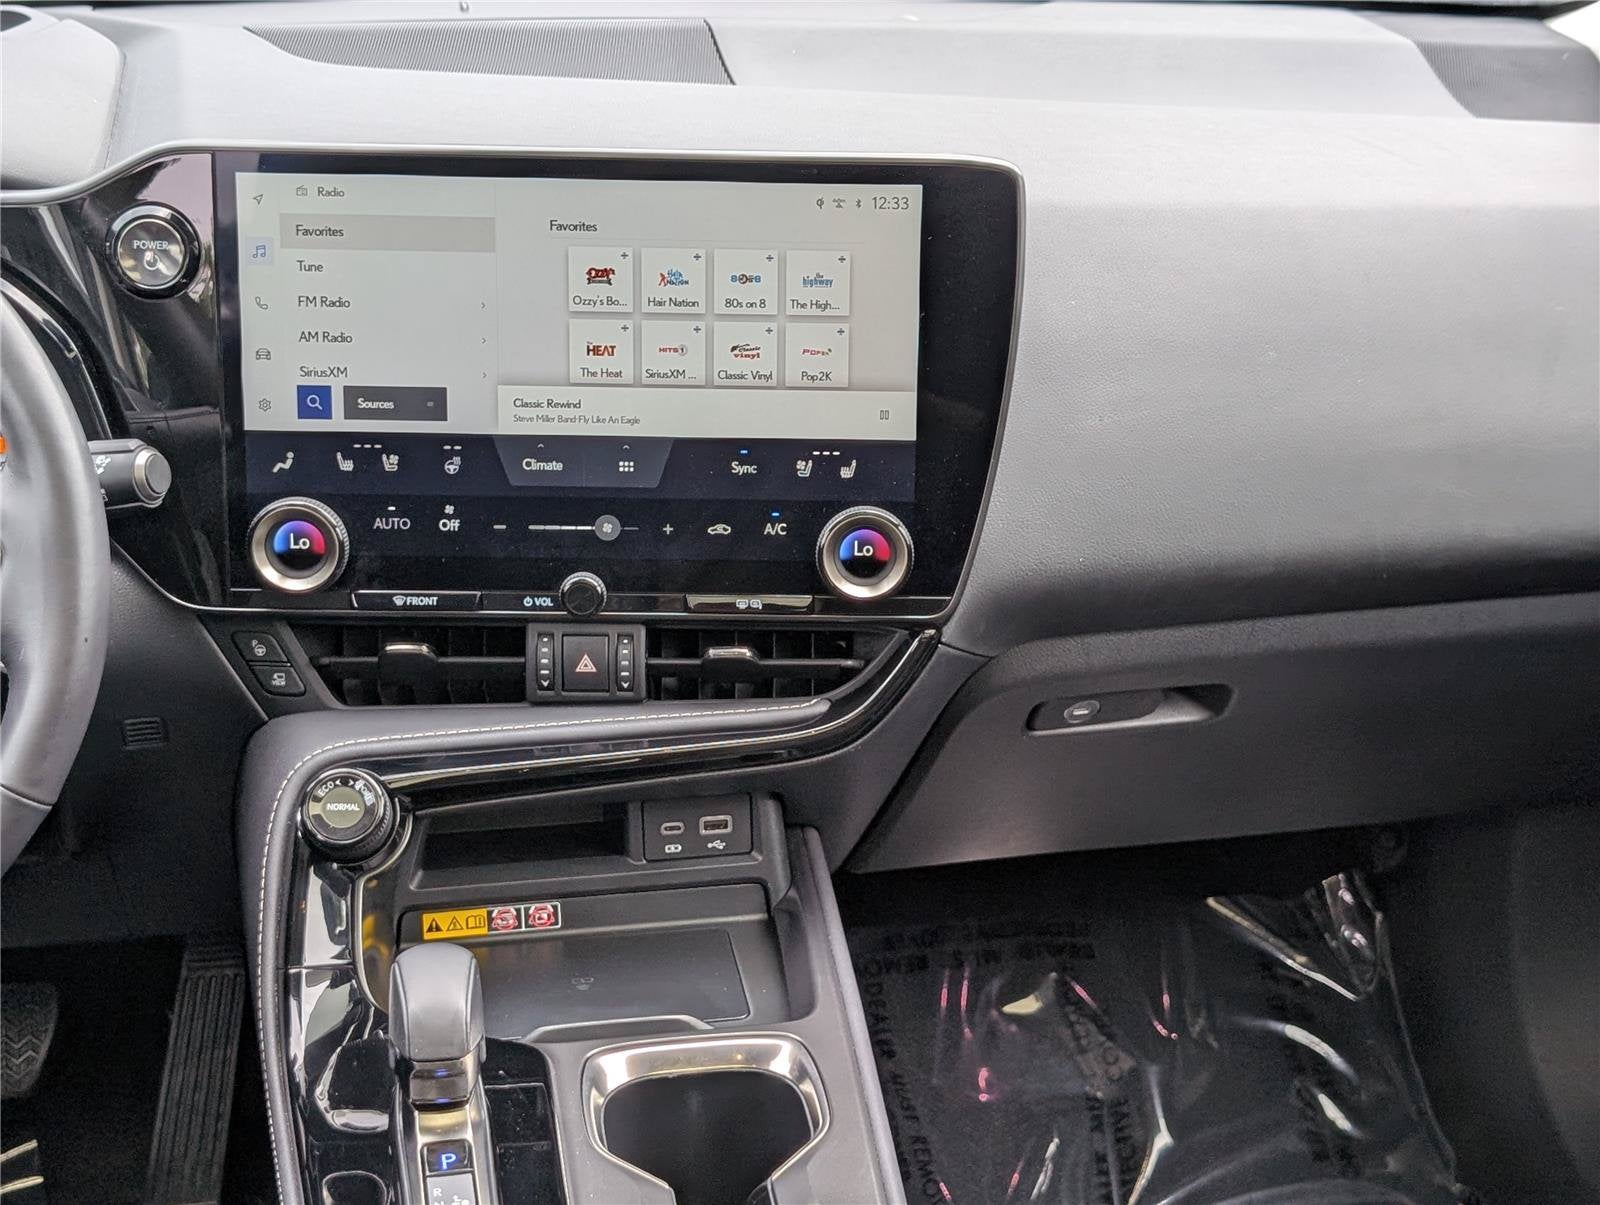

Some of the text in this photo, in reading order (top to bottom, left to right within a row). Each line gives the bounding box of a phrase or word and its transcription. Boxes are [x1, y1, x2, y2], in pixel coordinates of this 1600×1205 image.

[317, 187, 345, 198] Radio
[871, 196, 910, 210] 12:33
[295, 225, 344, 237] Favorites
[549, 219, 598, 233] Favorites
[133, 240, 169, 250] POWER
[296, 260, 324, 273] Tune
[297, 296, 351, 308] FM Radio
[572, 295, 628, 308] Ozzy's Bo...
[647, 297, 700, 308] Hair Nation
[724, 298, 767, 309] 80s on 8
[790, 299, 840, 312] The High...
[299, 331, 353, 344] AM Radio
[586, 345, 617, 356] HEAT
[299, 366, 348, 379] SiriusXM
[580, 367, 623, 378] The Heat
[645, 369, 686, 380] SiriusXM
[717, 370, 773, 382] Classic Vinyl
[801, 371, 832, 383] Pop2K
[357, 397, 395, 410] Sources
[513, 398, 582, 409] Classic Rewind
[513, 414, 535, 423] Steve
[536, 415, 556, 423] Miller
[591, 415, 607, 424] Like
[607, 416, 620, 424] An
[620, 416, 641, 426] Eagle
[522, 459, 563, 472] Climate
[731, 462, 758, 475] Sync
[373, 518, 411, 531] AUTO
[438, 519, 460, 532] Off
[763, 523, 788, 536] A/C
[289, 533, 310, 550] Lo
[853, 540, 874, 557] Lo
[406, 596, 438, 606] FRONT
[533, 597, 554, 607] VOL
[317, 782, 335, 797] ECO
[326, 802, 361, 811] NORMAL
[441, 1153, 457, 1170] P
[433, 1187, 442, 1197] R
